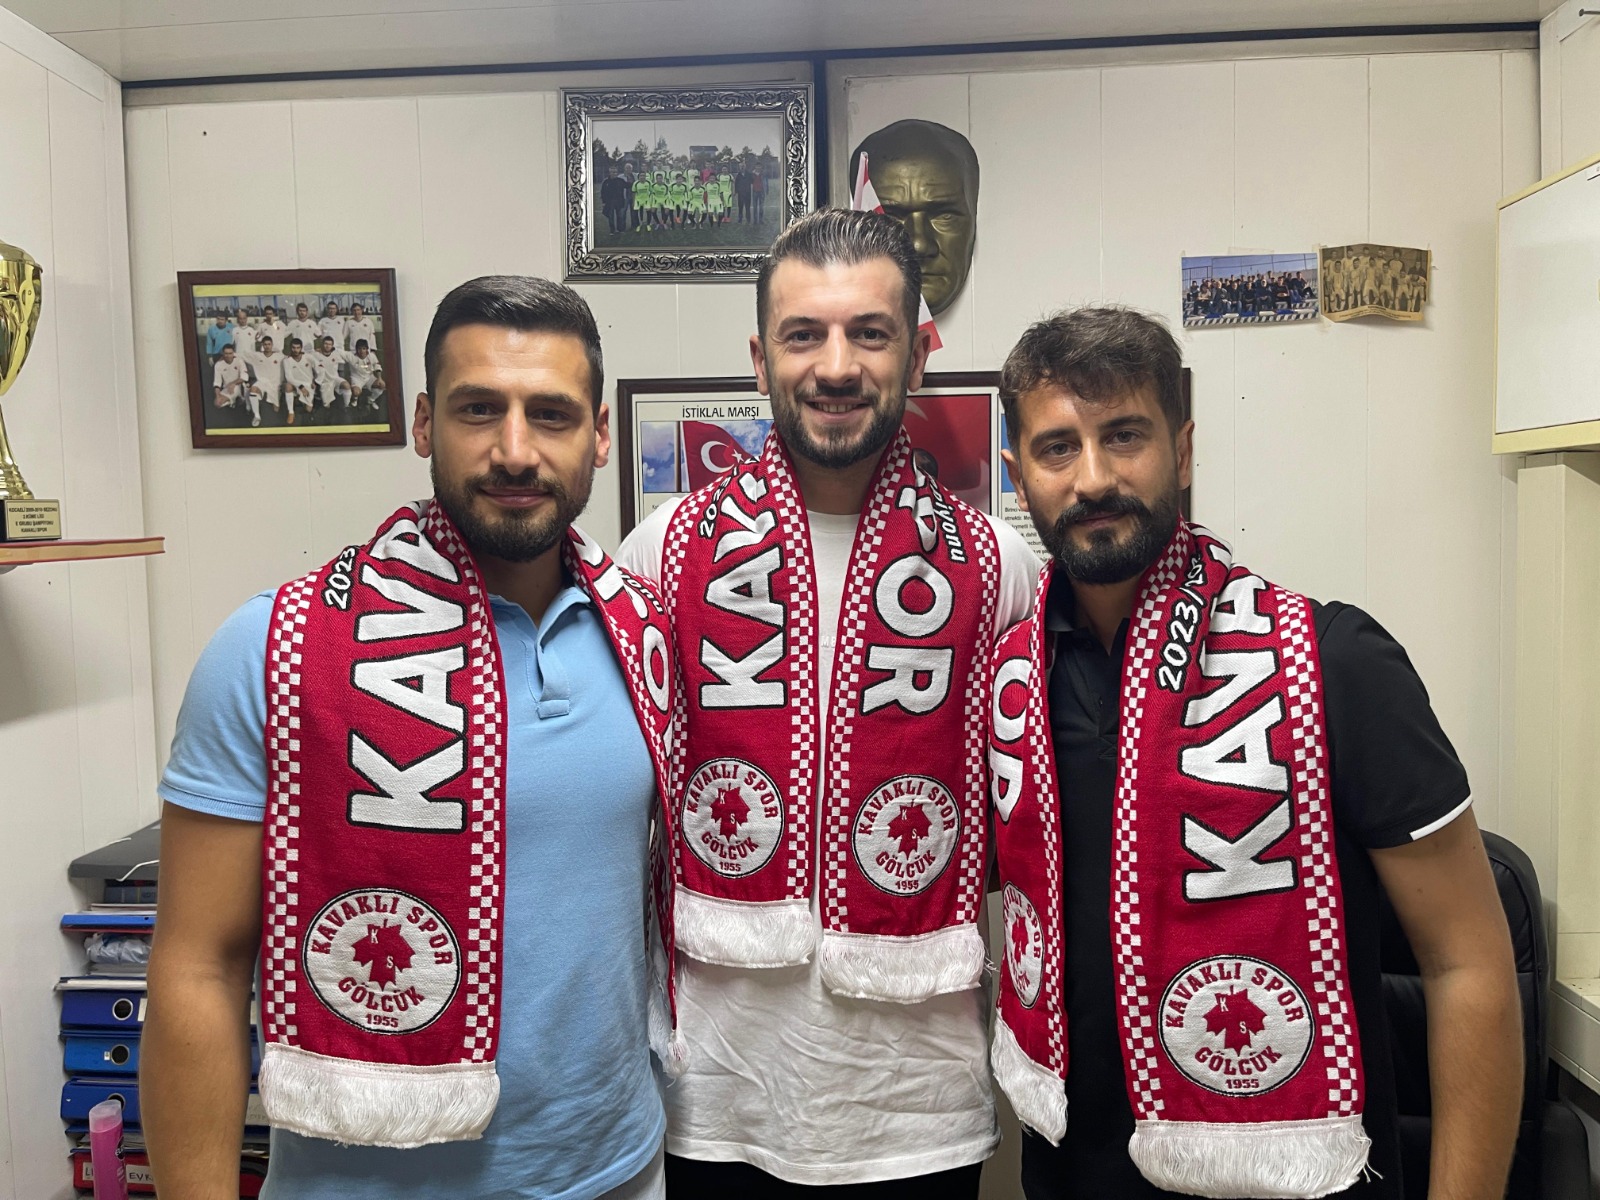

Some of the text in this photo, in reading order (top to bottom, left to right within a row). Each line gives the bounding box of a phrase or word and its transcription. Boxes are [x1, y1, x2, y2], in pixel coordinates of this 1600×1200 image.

[682, 405, 759, 420] İSTİKLAL MARŞI
[686, 763, 779, 819] KAVAKLI SPOR
[858, 780, 956, 836] KAVAKLI SPOR
[701, 831, 760, 861] GÖLCÜK
[719, 861, 742, 872] 1955
[875, 849, 936, 878] GÖLCÜK
[895, 880, 920, 891] 1955
[310, 894, 454, 965] KAVAKLI SPOR
[338, 976, 426, 1013] GÖLCÜK
[1165, 962, 1305, 1029] KAVAKLI SPOR
[365, 1012, 399, 1028] 1955
[1194, 1045, 1283, 1076] GÖLCÜK
[1224, 1078, 1260, 1090] 1955
